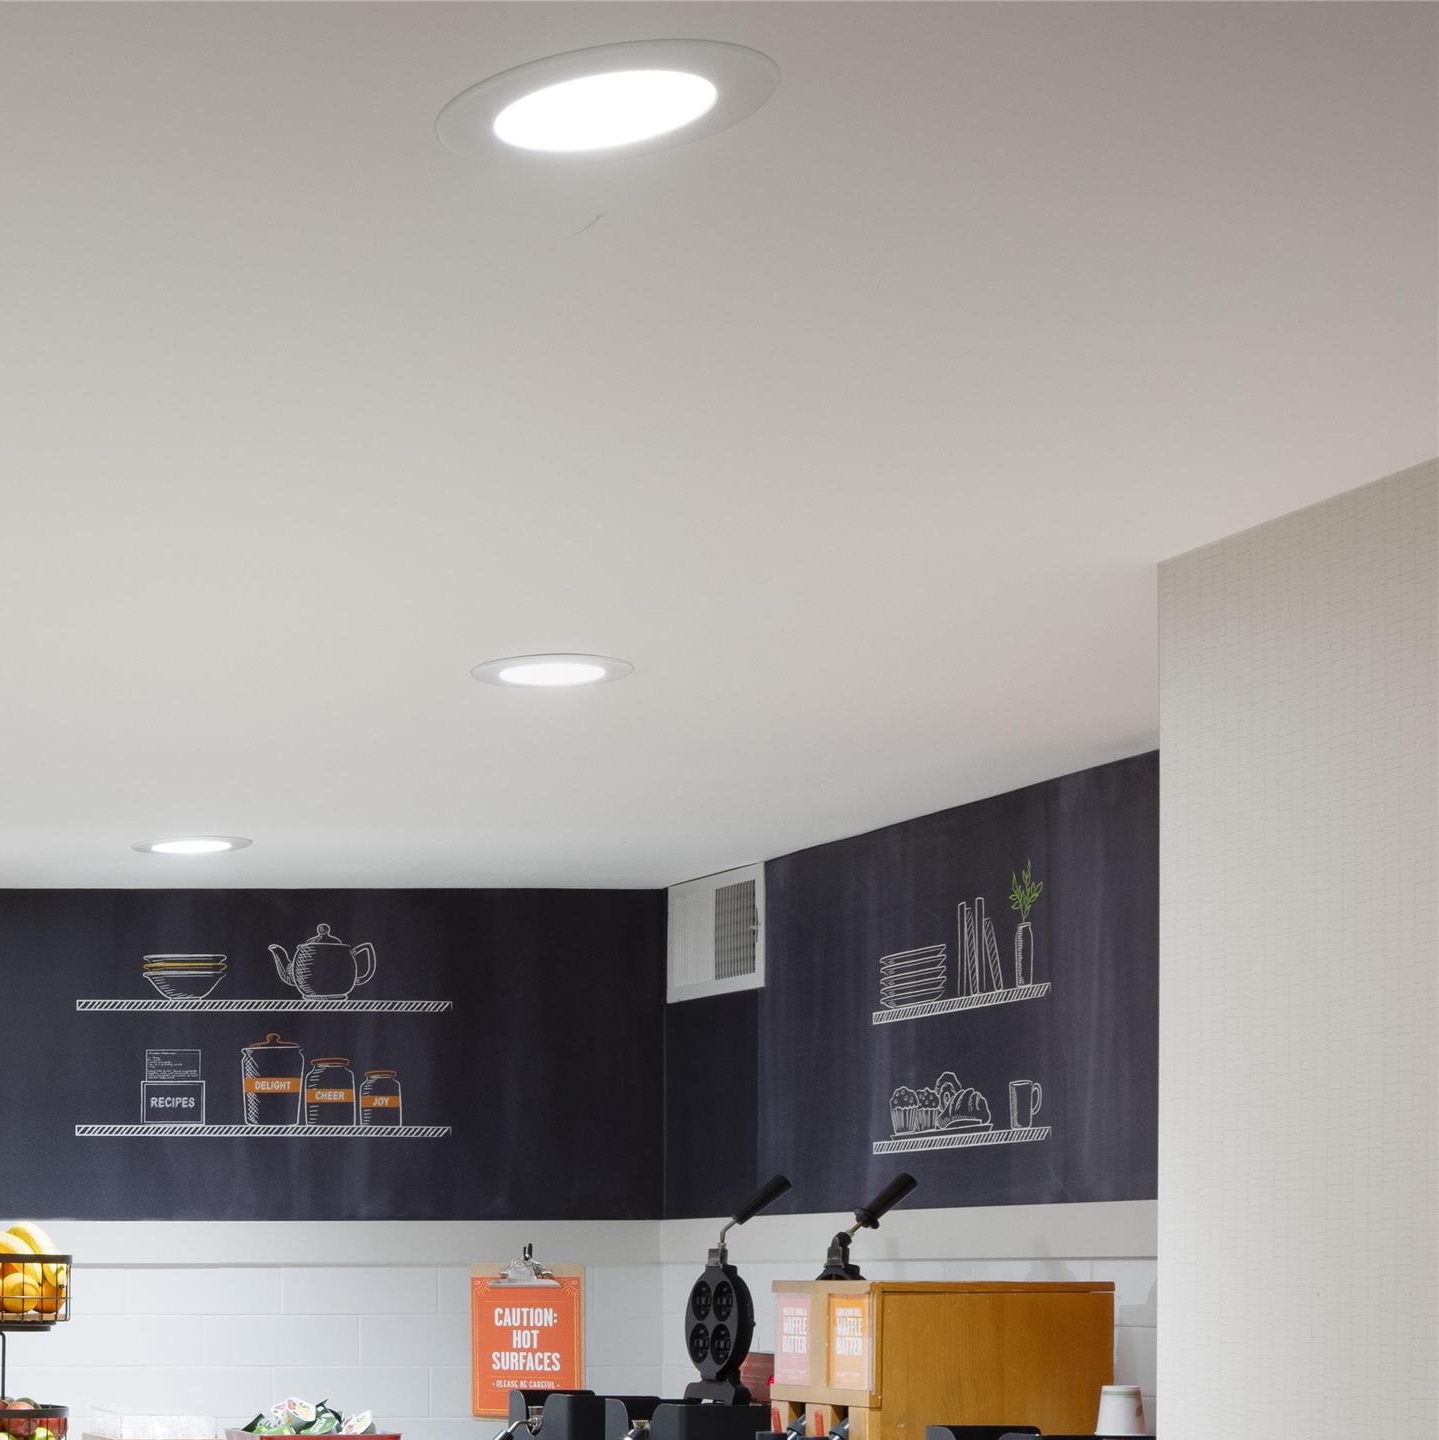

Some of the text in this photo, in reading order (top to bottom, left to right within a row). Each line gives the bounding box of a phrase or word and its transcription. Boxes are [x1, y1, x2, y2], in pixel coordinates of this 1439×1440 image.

[254, 1081, 292, 1091] DELIGHT
[150, 1096, 196, 1109] RECIPES
[315, 1091, 345, 1101] CHEER
[373, 1097, 390, 1106] JOY
[494, 1307, 558, 1327] CAUTION:
[783, 1316, 807, 1335] WAFFLE
[835, 1316, 863, 1337] WAFFLE
[512, 1329, 539, 1349] HOT
[783, 1335, 807, 1354] BATTER
[835, 1337, 863, 1356] BATTER
[491, 1351, 561, 1371] SURFACES
[496, 1379, 555, 1389] PLEASE BE CAREFUL
